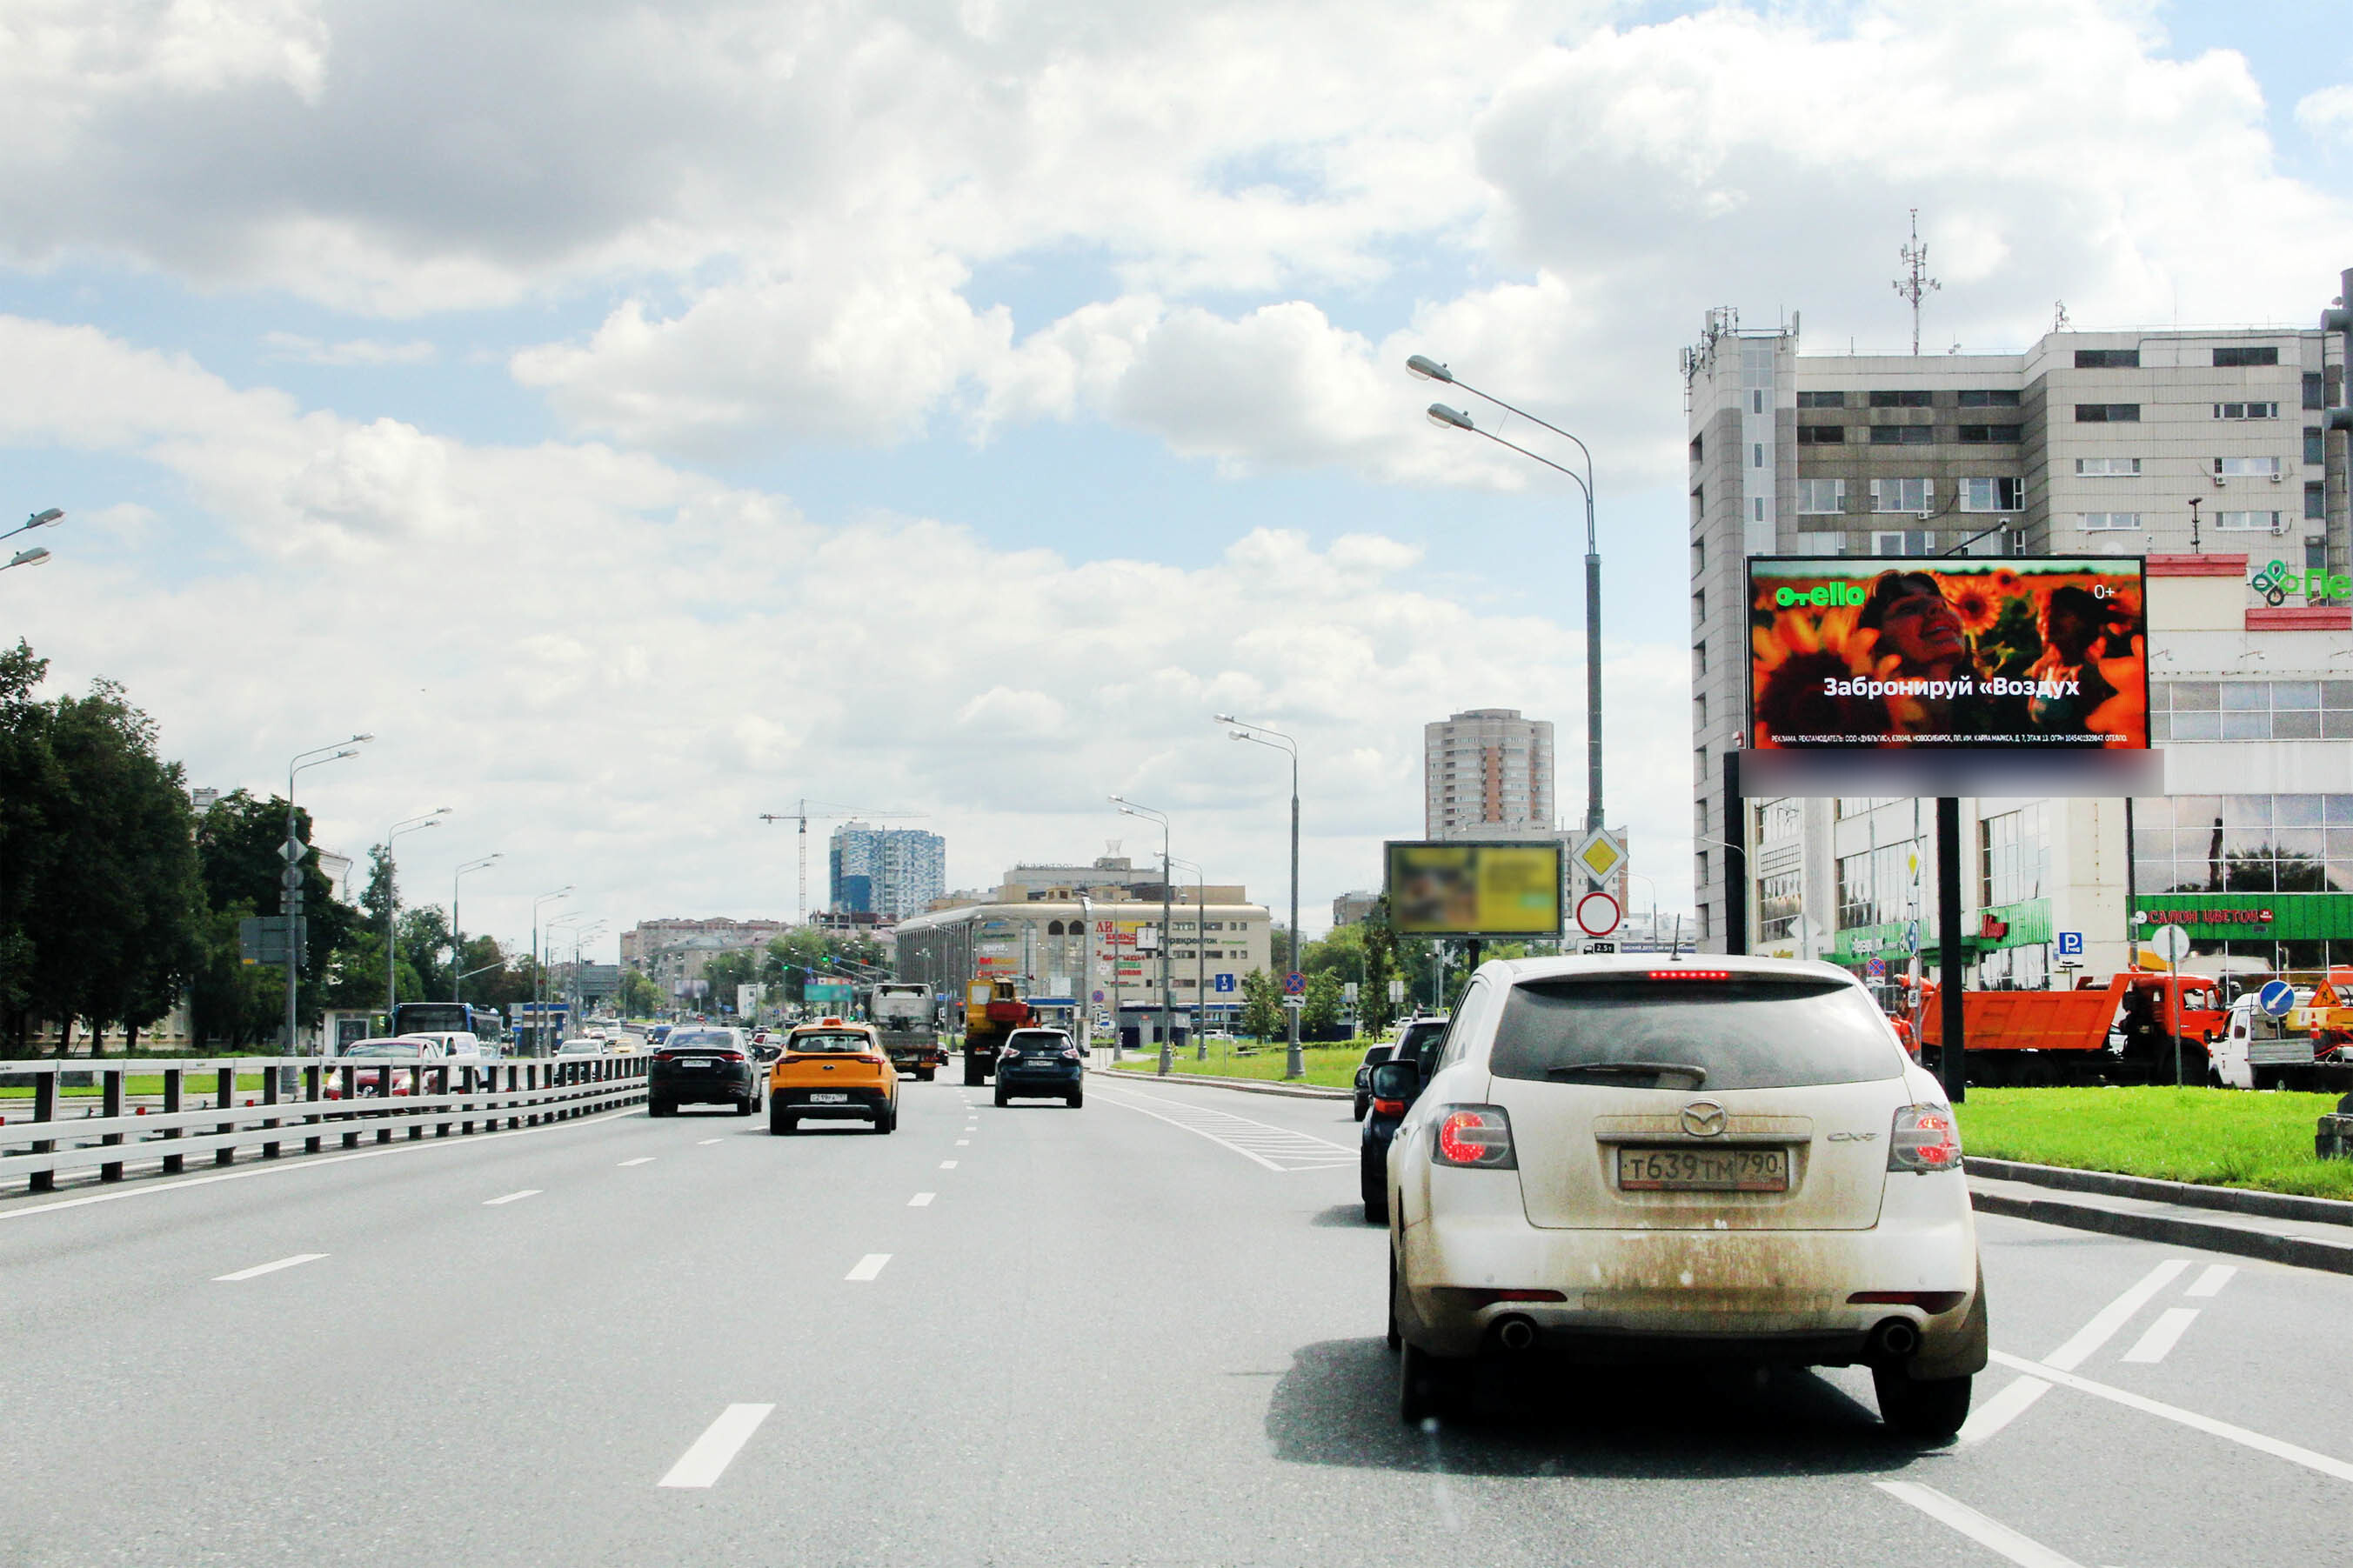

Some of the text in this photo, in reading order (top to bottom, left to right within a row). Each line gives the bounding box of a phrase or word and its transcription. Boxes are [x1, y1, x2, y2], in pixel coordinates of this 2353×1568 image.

[2094, 584, 2116, 600] 0+
[1823, 677, 2080, 699] Забронируй «Воздух
[2148, 910, 2258, 924] САЛОН ЦВЕТОВ
[1740, 1153, 1778, 1173] 790
